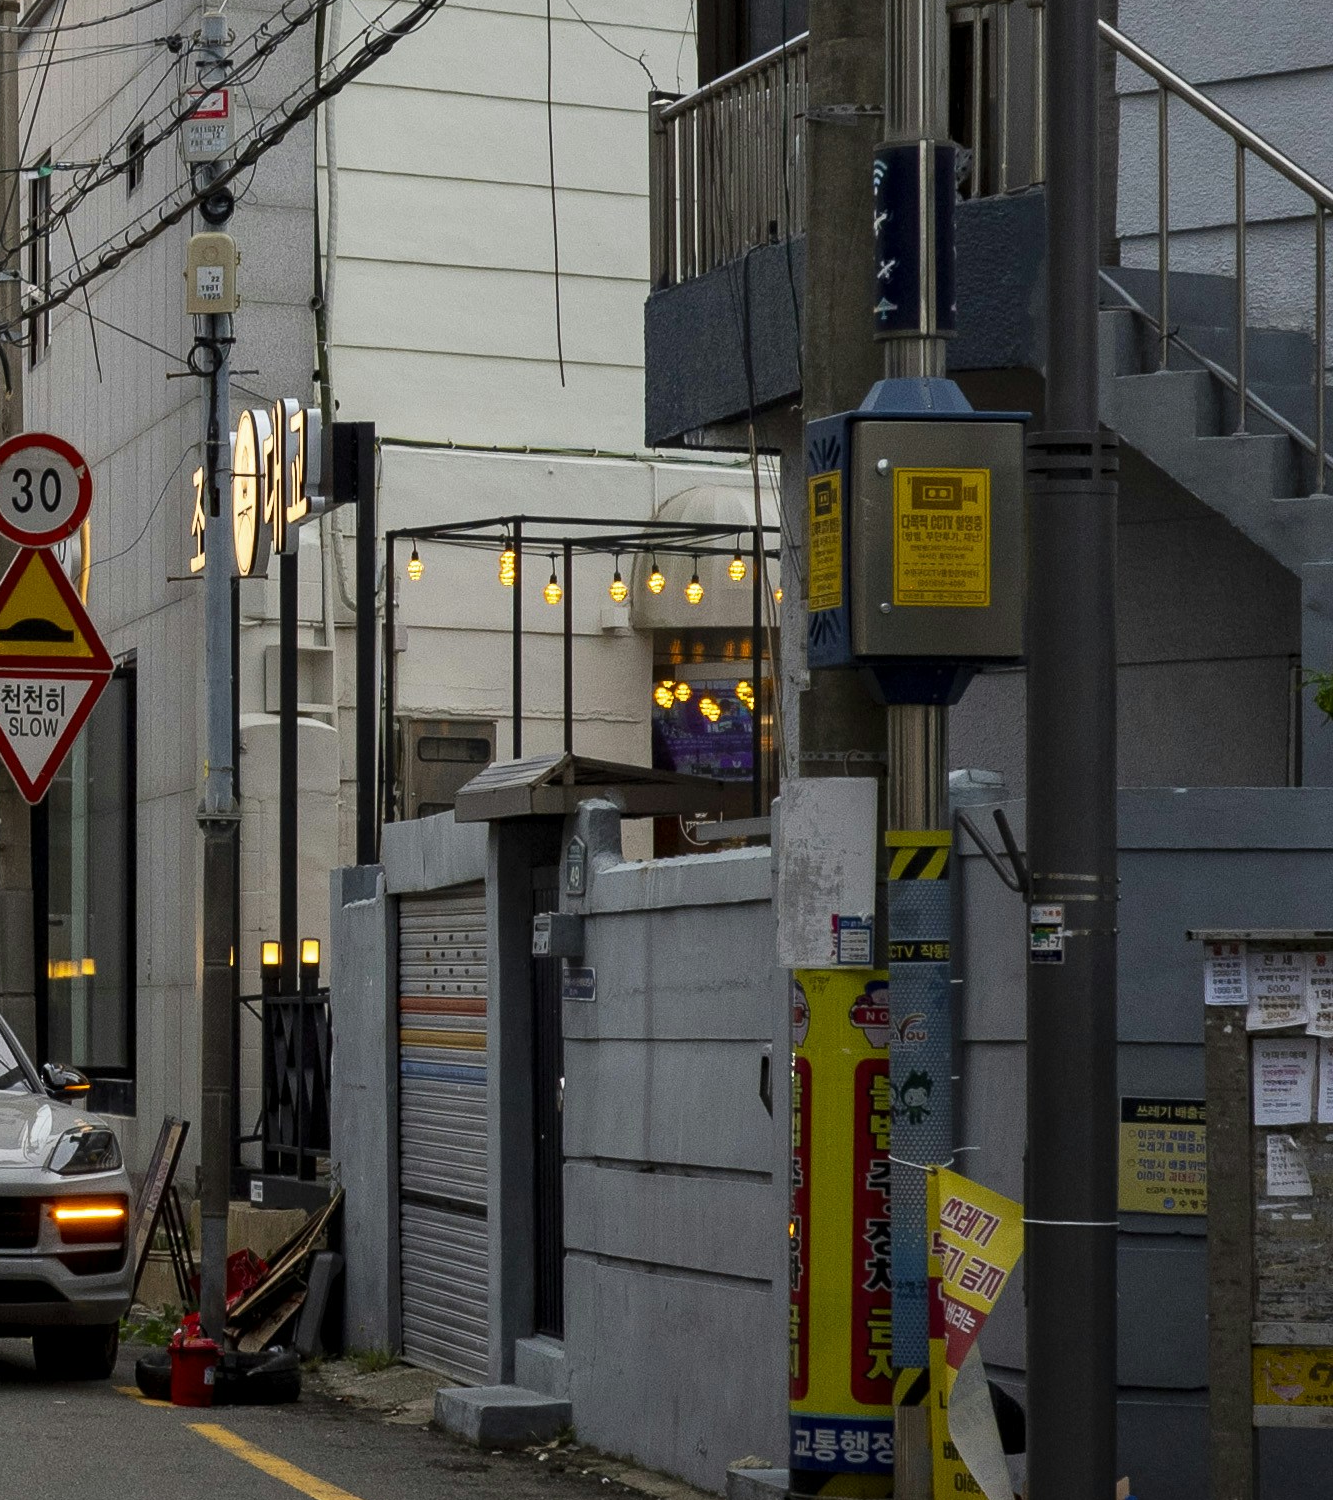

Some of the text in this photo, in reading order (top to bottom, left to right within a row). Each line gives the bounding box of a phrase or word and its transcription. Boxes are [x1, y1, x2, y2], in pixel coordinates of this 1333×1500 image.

[11, 467, 62, 514] 30
[0, 683, 66, 717] 천천히
[8, 716, 60, 738] SLOW
[569, 866, 580, 888] 49
[1136, 1105, 1171, 1119] 쓰레기
[940, 1196, 1001, 1248] 쓰레기
[957, 1256, 1007, 1303] 금지
[793, 1427, 895, 1465] 교통행정
